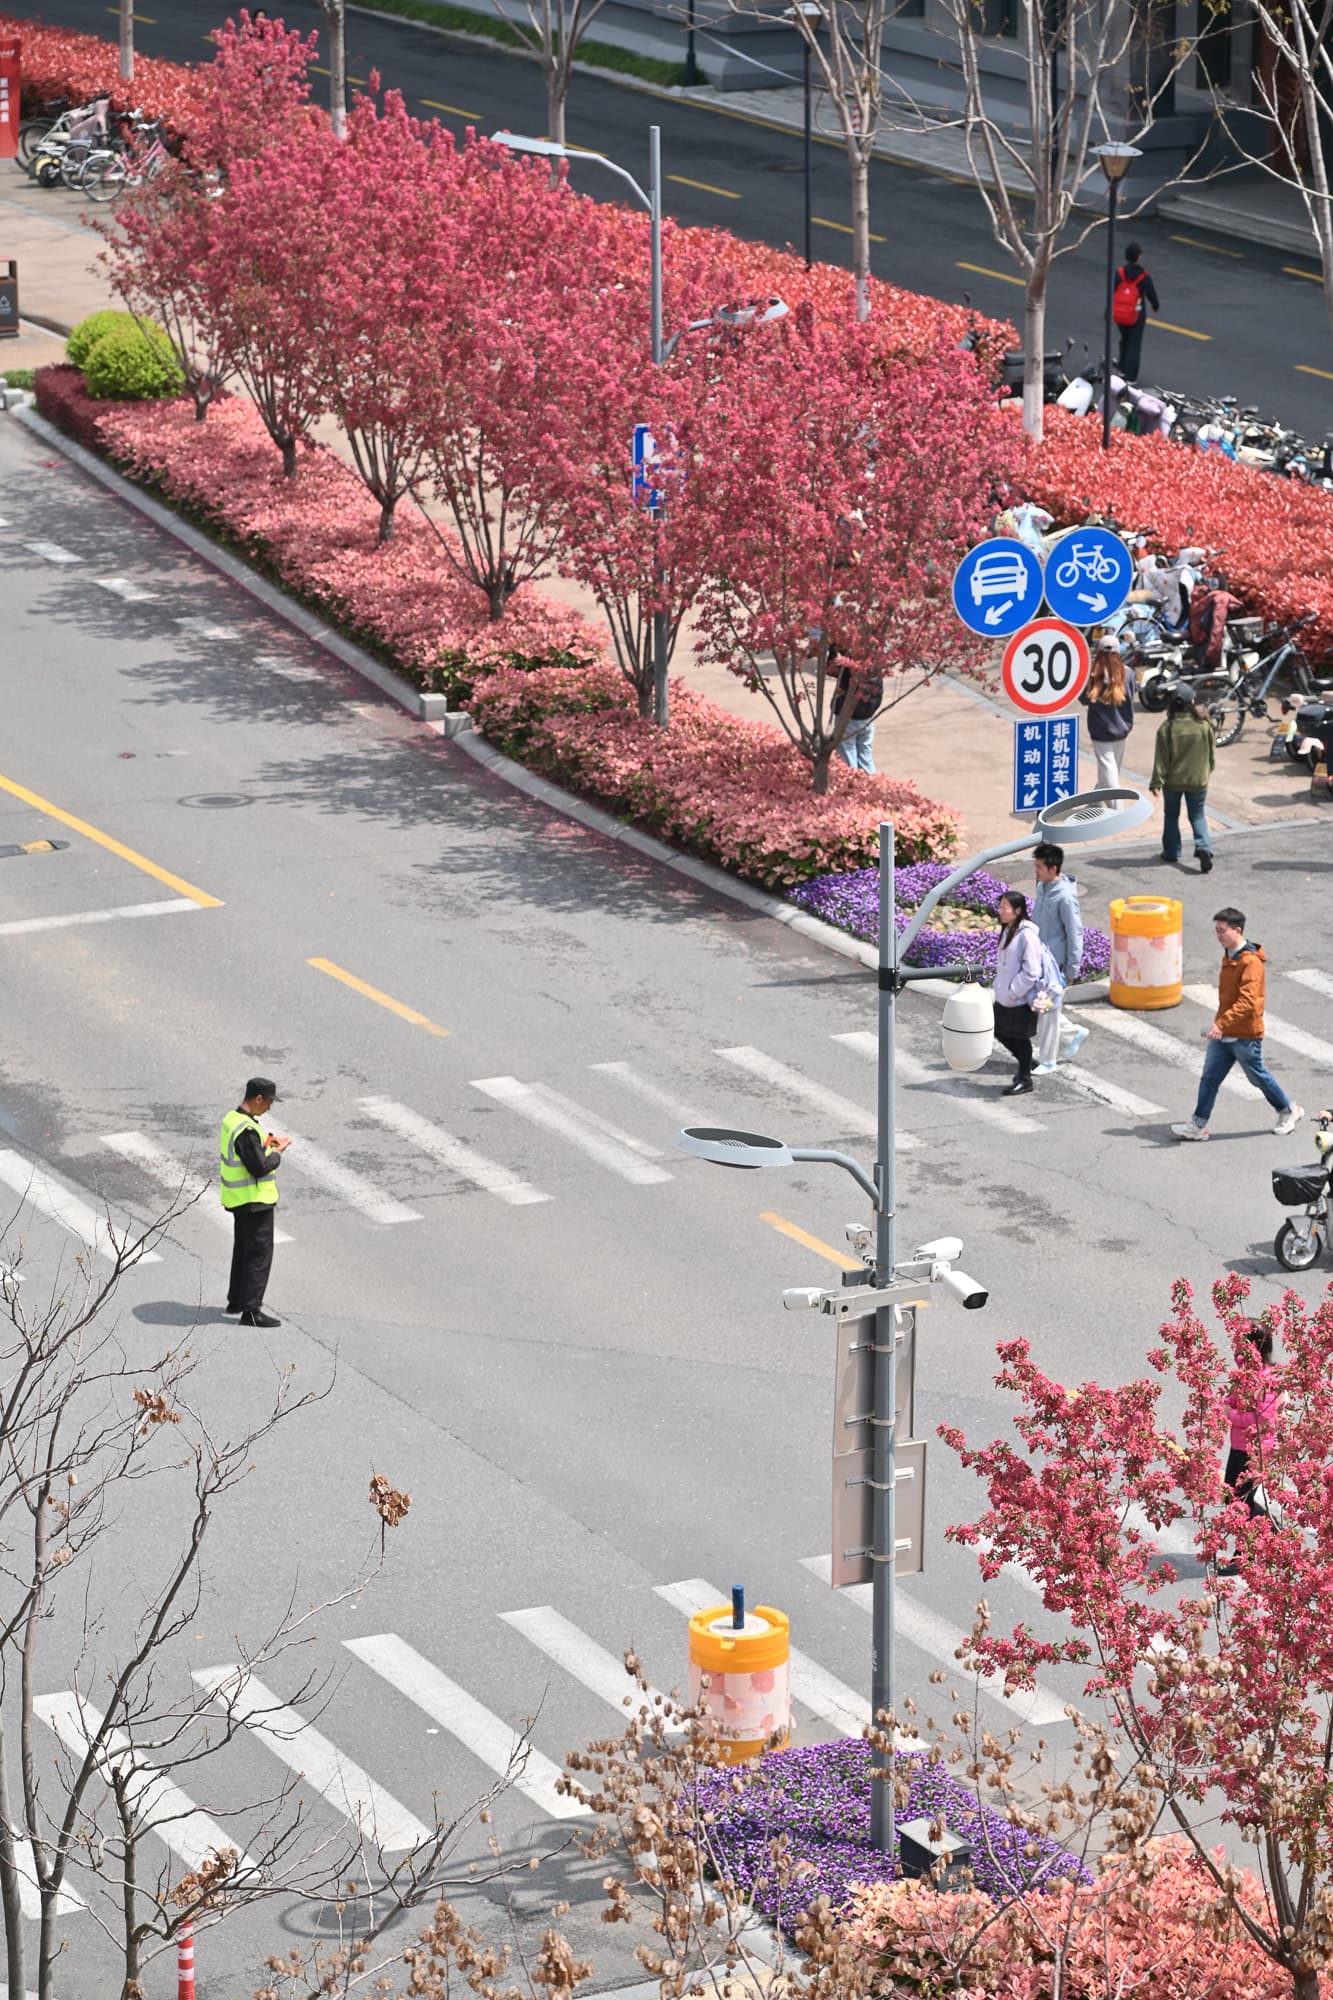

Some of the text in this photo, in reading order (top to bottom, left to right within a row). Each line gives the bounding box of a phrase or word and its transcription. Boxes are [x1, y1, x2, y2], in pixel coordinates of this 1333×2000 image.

[1021, 641, 1072, 693] 30
[1023, 725, 1042, 788] 机动车
[1052, 722, 1071, 785] 非机动车
